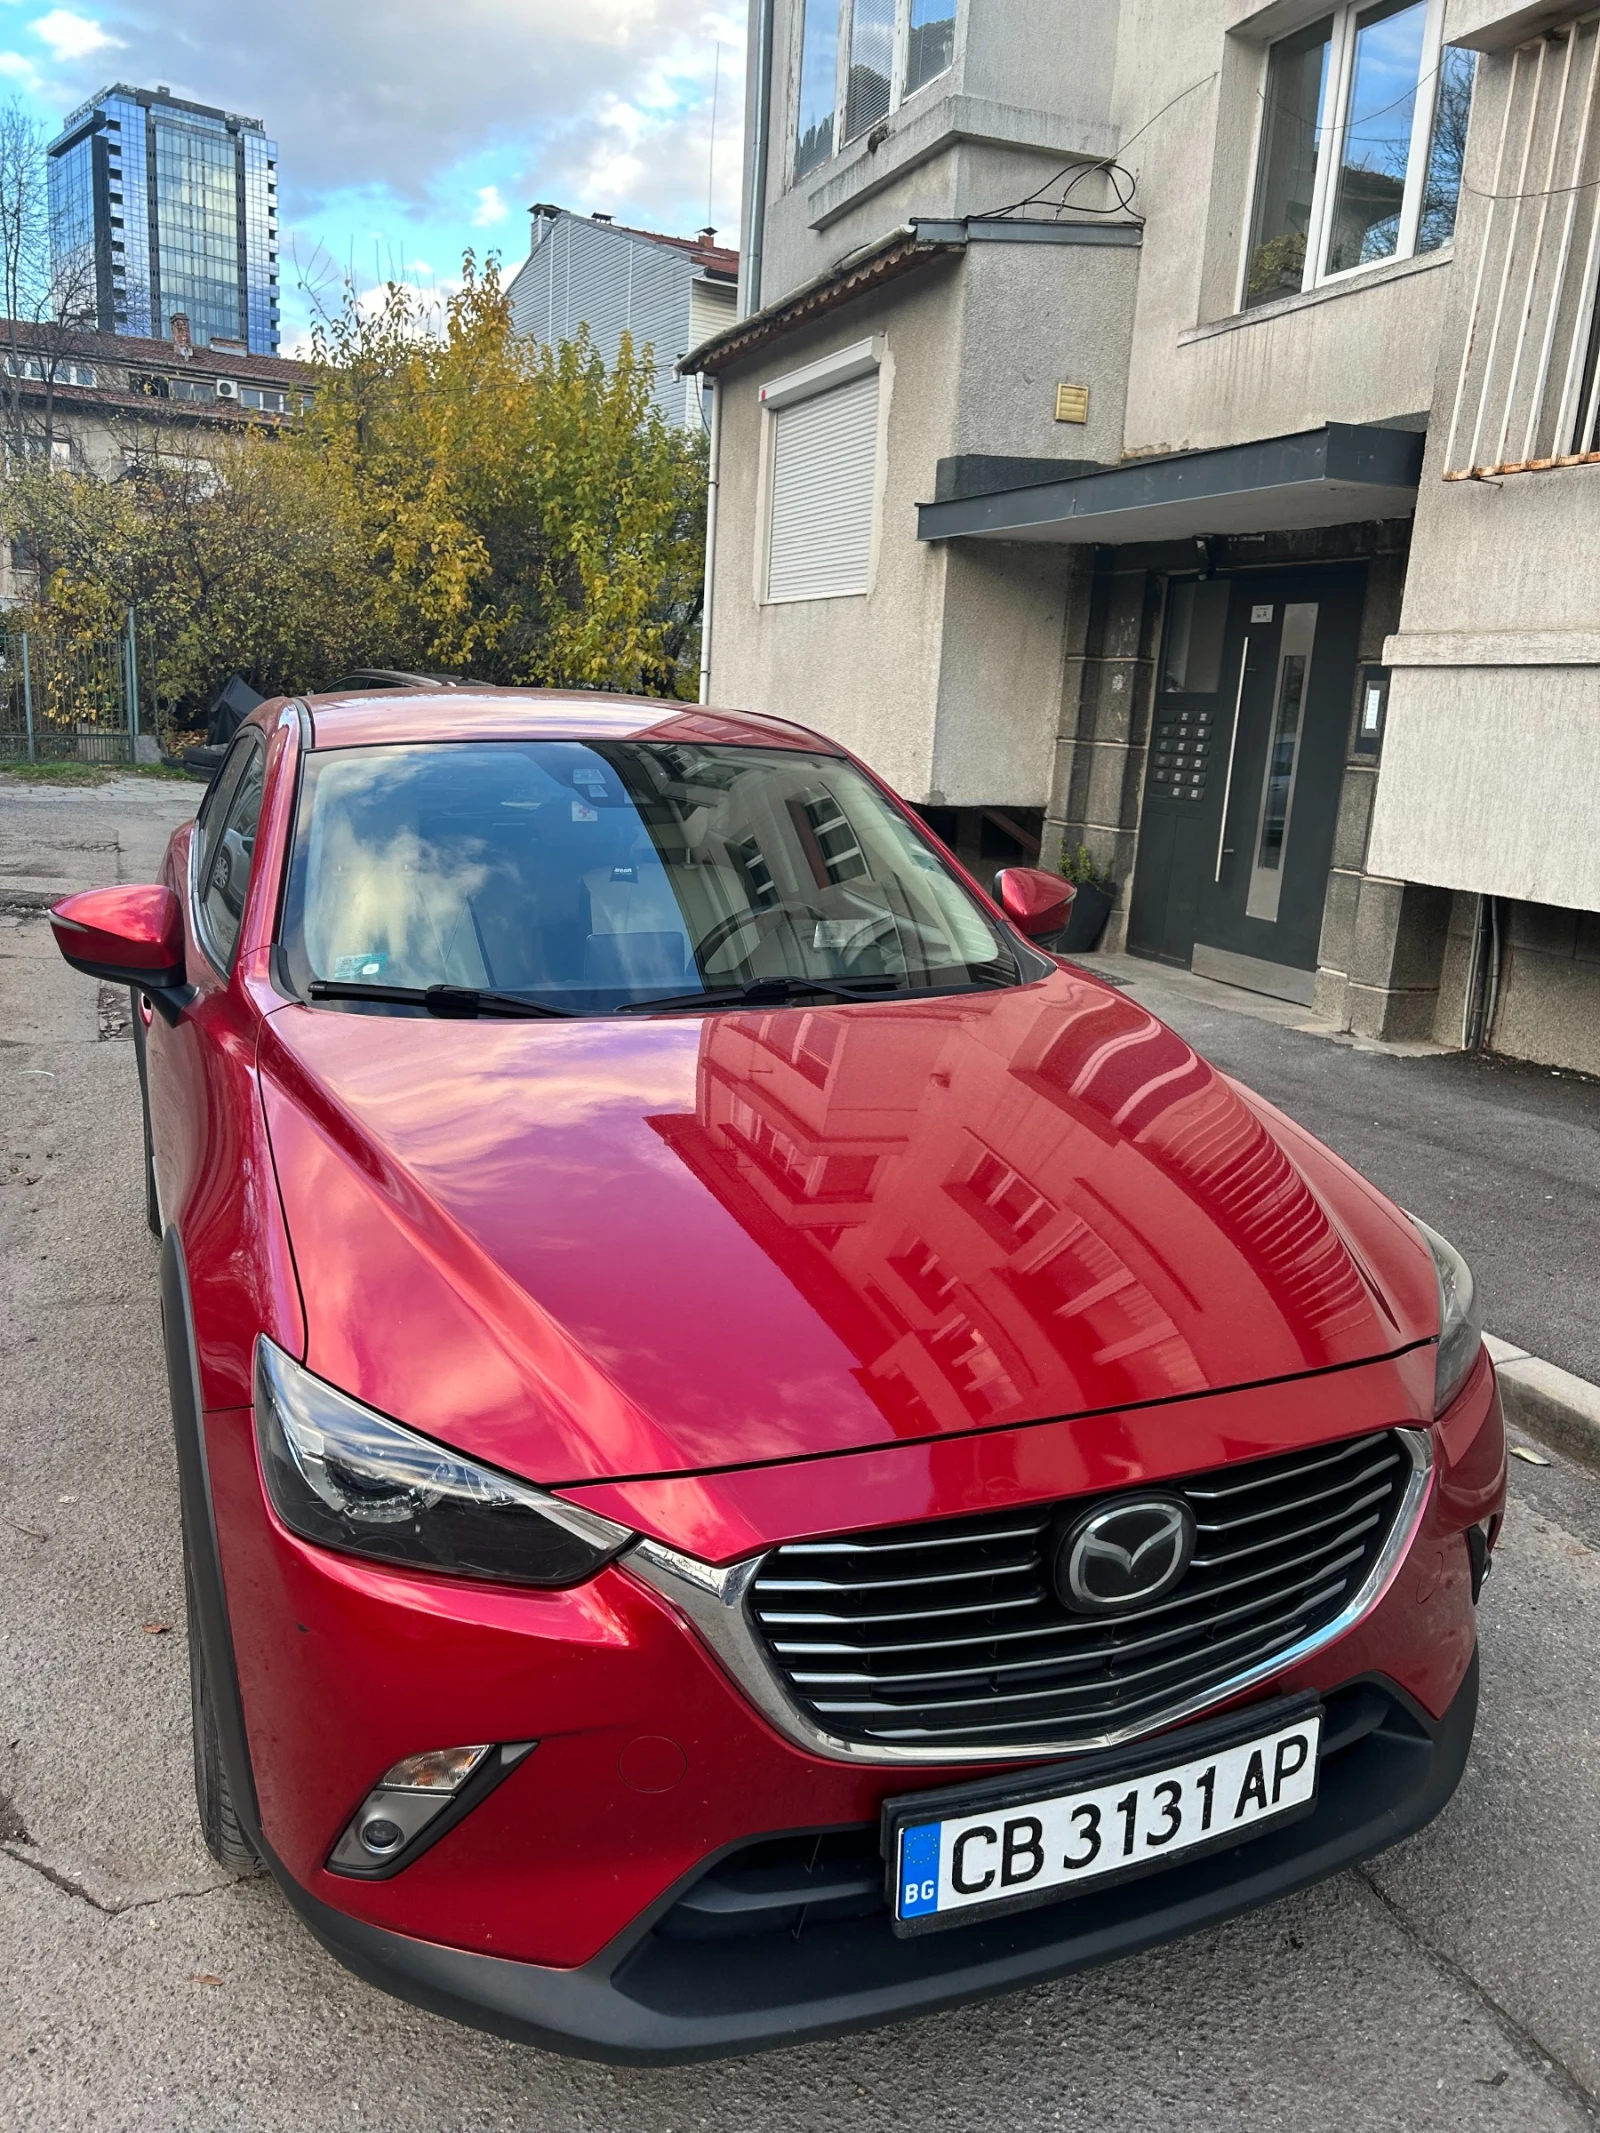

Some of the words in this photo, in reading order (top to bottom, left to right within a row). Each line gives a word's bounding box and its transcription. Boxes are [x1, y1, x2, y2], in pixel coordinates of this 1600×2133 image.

[952, 1817, 1044, 1895] CB
[1063, 1765, 1217, 1870] 3131
[1234, 1734, 1309, 1820] AP
[905, 1879, 935, 1904] BG
